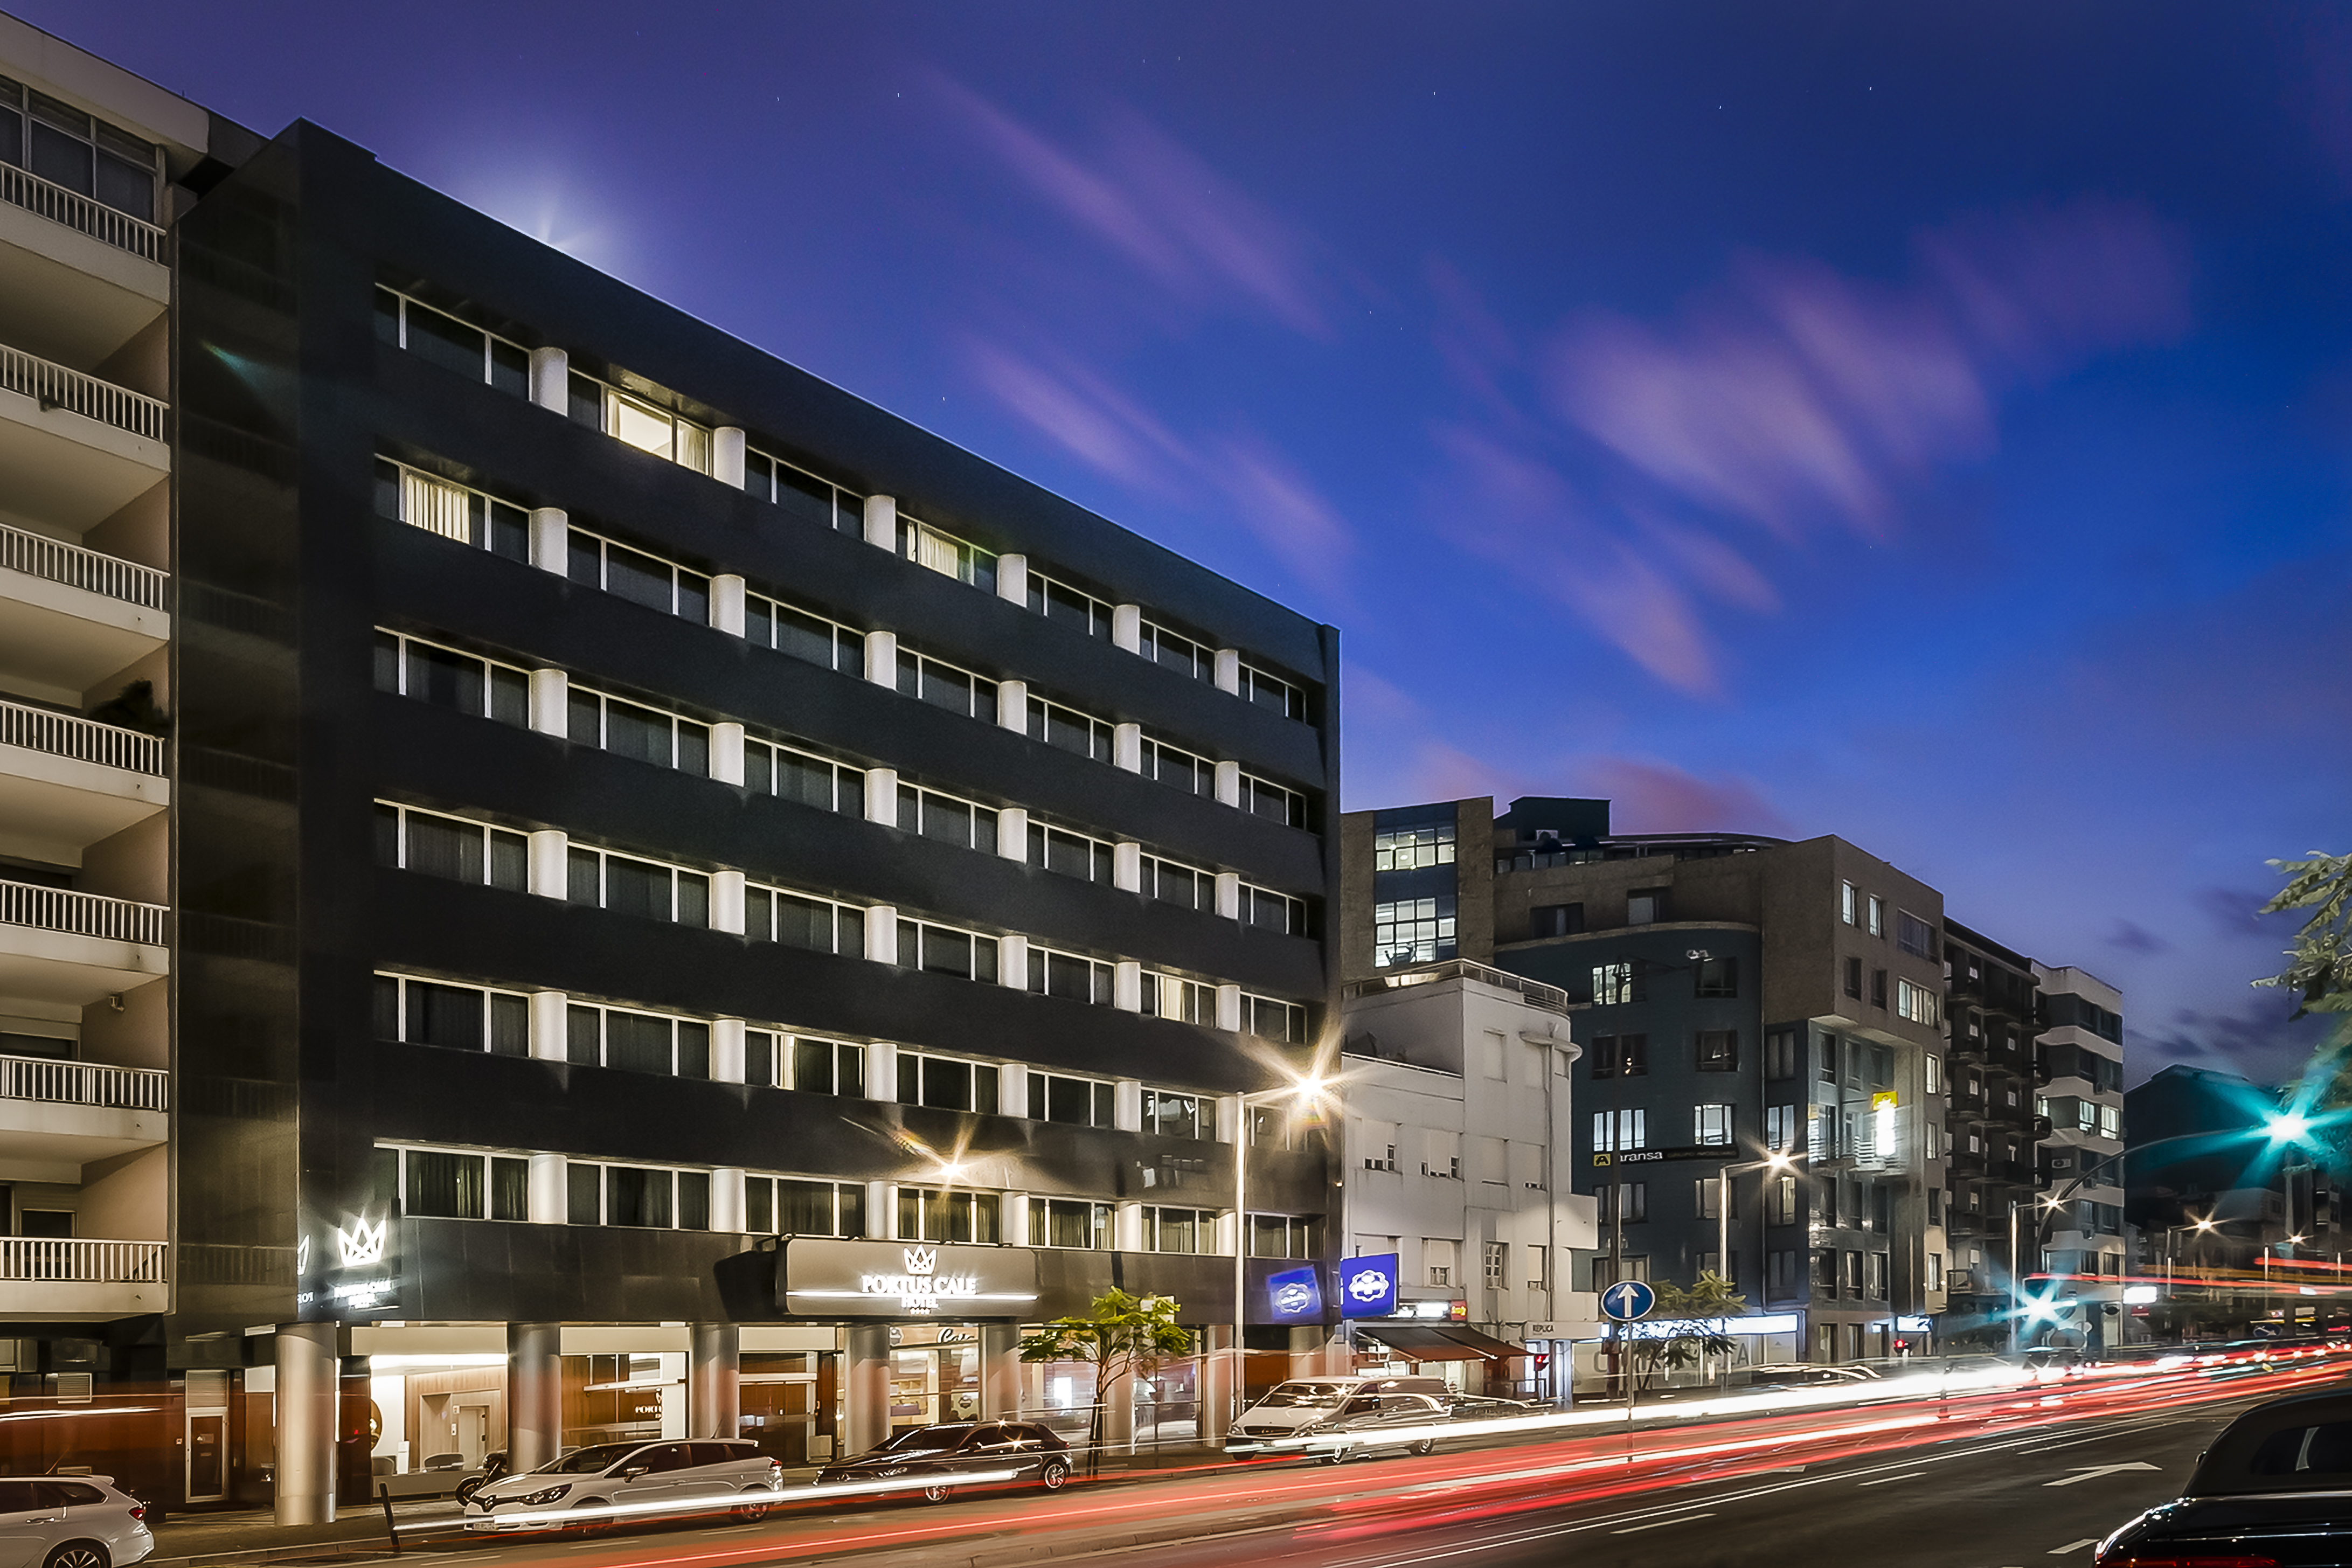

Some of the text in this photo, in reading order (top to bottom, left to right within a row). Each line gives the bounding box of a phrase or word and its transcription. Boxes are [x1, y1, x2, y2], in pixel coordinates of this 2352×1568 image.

[862, 1275, 976, 1295] PORTUS CALE
[901, 1295, 939, 1308] HOTEL
